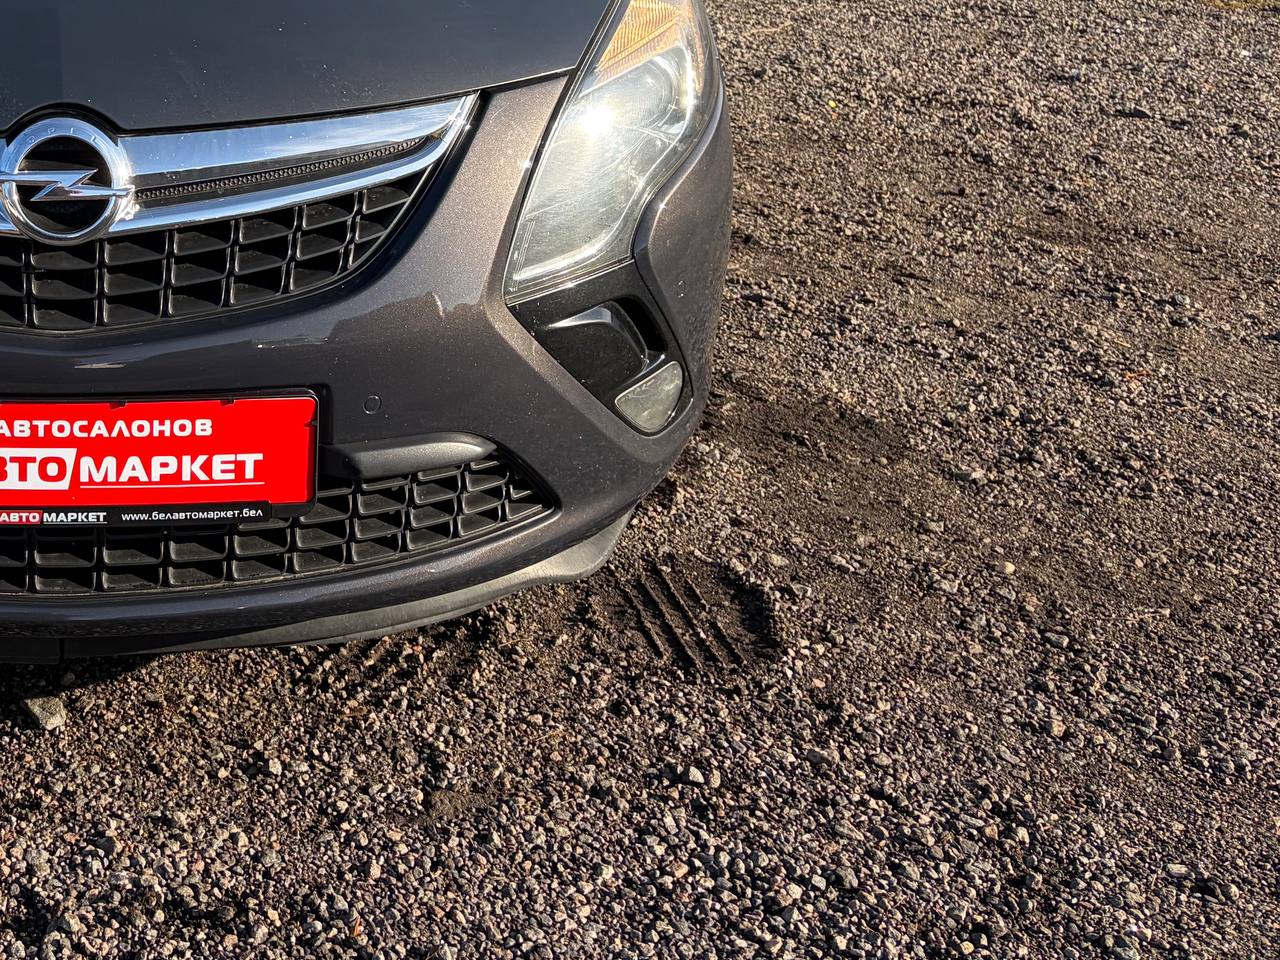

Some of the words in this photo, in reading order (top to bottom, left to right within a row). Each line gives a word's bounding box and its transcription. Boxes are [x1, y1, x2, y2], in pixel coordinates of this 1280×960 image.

[79, 452, 264, 483] МАРКЕТ
[43, 511, 107, 523] МАРКЕТ
[121, 508, 263, 522] www.белавтомаркет.бел
